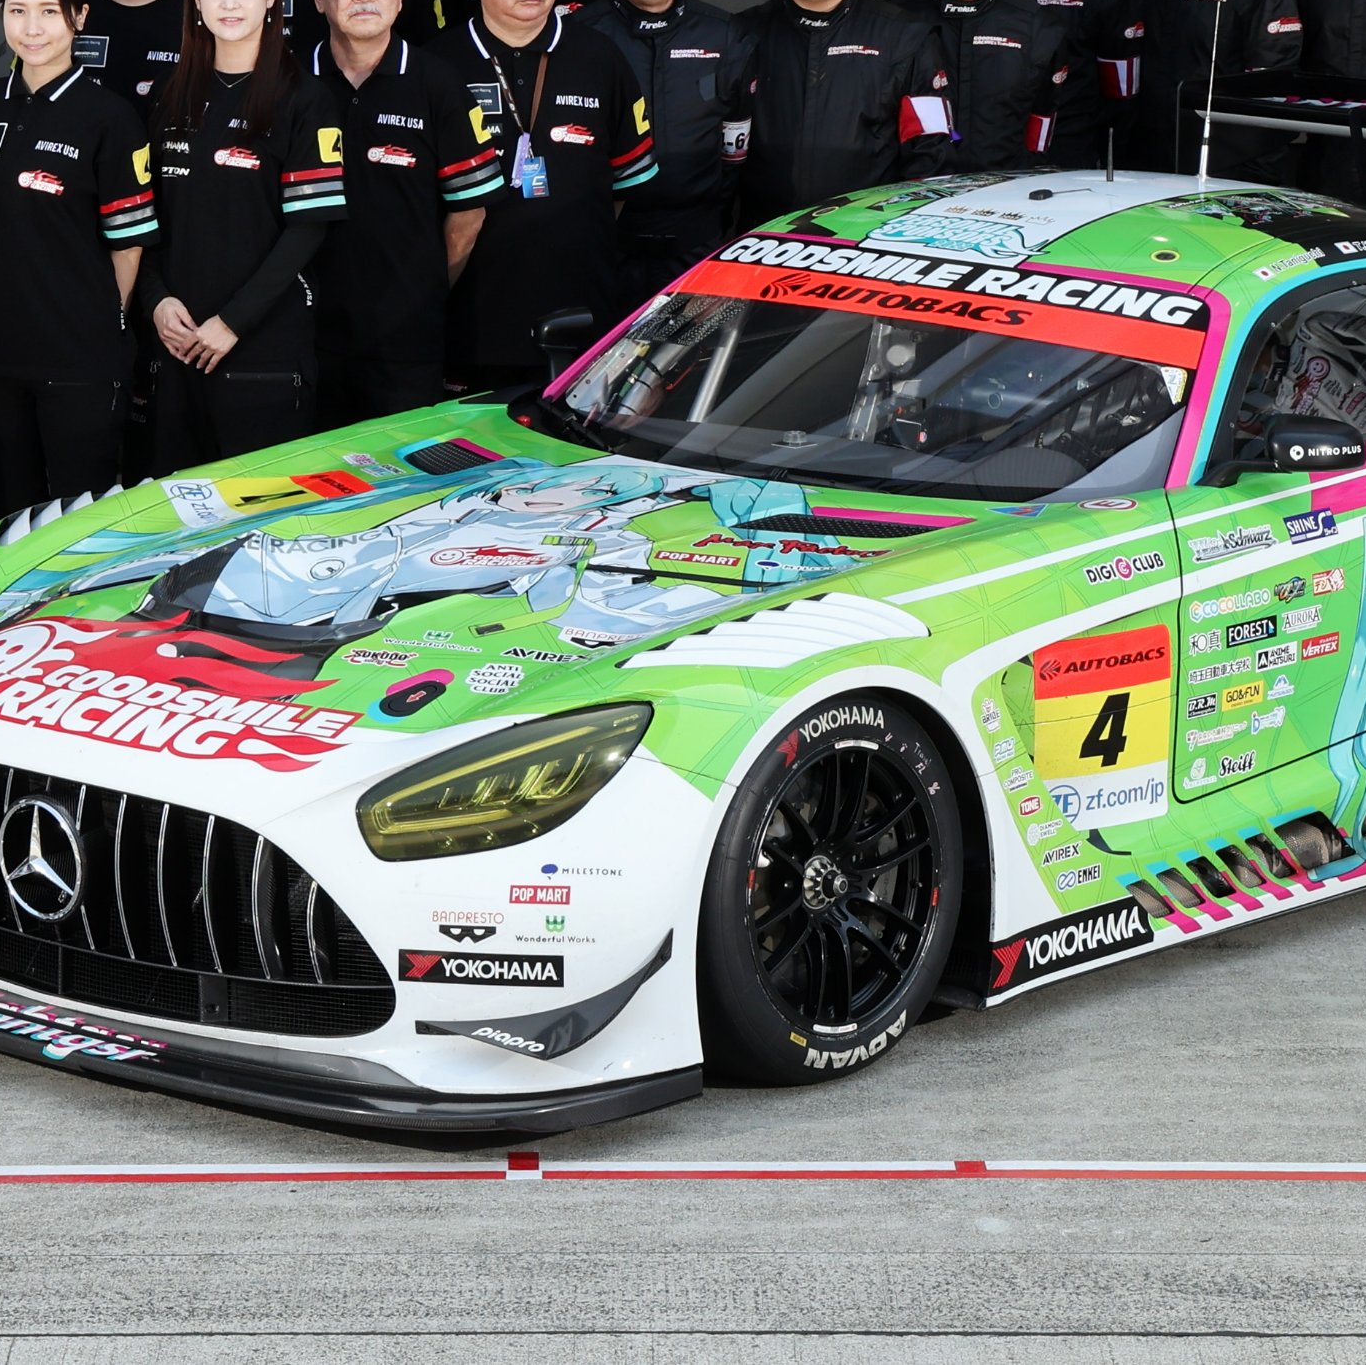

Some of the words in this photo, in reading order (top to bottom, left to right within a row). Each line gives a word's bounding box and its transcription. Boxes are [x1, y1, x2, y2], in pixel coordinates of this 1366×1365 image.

[147, 50, 173, 62] AVIREX
[556, 95, 583, 107] AVIREX
[583, 97, 600, 109] USA
[378, 114, 407, 127] AVIREX
[407, 117, 423, 130] USA
[35, 140, 64, 154] AVIREX
[63, 145, 79, 160] USA
[1272, 247, 1325, 273] N.Taniguchi
[719, 236, 968, 292] GOODSMILE
[965, 268, 1203, 326] RACING
[806, 281, 1033, 326] AUTOBACS
[1308, 446, 1341, 458] NITRO
[1342, 444, 1362, 456] PLUS
[659, 551, 690, 563] POP
[693, 553, 738, 566] MART
[1132, 553, 1164, 571] CLUB
[1085, 565, 1117, 584] DIGI
[1202, 591, 1270, 616] COCOLLABO
[1285, 607, 1320, 628] AURORA
[1229, 620, 1268, 643] FOREST
[1190, 630, 1221, 654] 和真
[1270, 646, 1290, 657] ANIME
[1302, 641, 1338, 658] VERTEX
[353, 650, 409, 661] SOKUDO
[504, 646, 586, 663] AVIREX
[1064, 647, 1165, 673] AUTOBACS
[473, 670, 521, 680] SOCIAL
[486, 664, 519, 672] ANTI
[1189, 659, 1251, 683] 埼玉自動車大学校
[469, 677, 516, 687] SOCIAL
[474, 686, 505, 694] CLUB
[41, 665, 355, 739] GOODSMILE
[799, 706, 885, 742] YOKOHAMA
[1079, 692, 1130, 767] 4
[1220, 751, 1255, 776] Steiff
[1085, 779, 1164, 811] zf.com/jp
[1021, 799, 1040, 813] TONE
[1042, 842, 1081, 865] AVIREX
[561, 867, 622, 877] MILESTONE
[1077, 864, 1101, 884] ENKEI
[511, 887, 534, 902] POP
[536, 887, 569, 903] MART
[432, 911, 504, 924] BANPRESTO
[515, 935, 565, 944] Wonderful
[566, 935, 596, 944] Works
[1025, 906, 1145, 969] YOKOHAMA
[441, 957, 558, 981] YOKOHAMA
[471, 1025, 545, 1054] piapro
[804, 1008, 909, 1069] ADVAN
